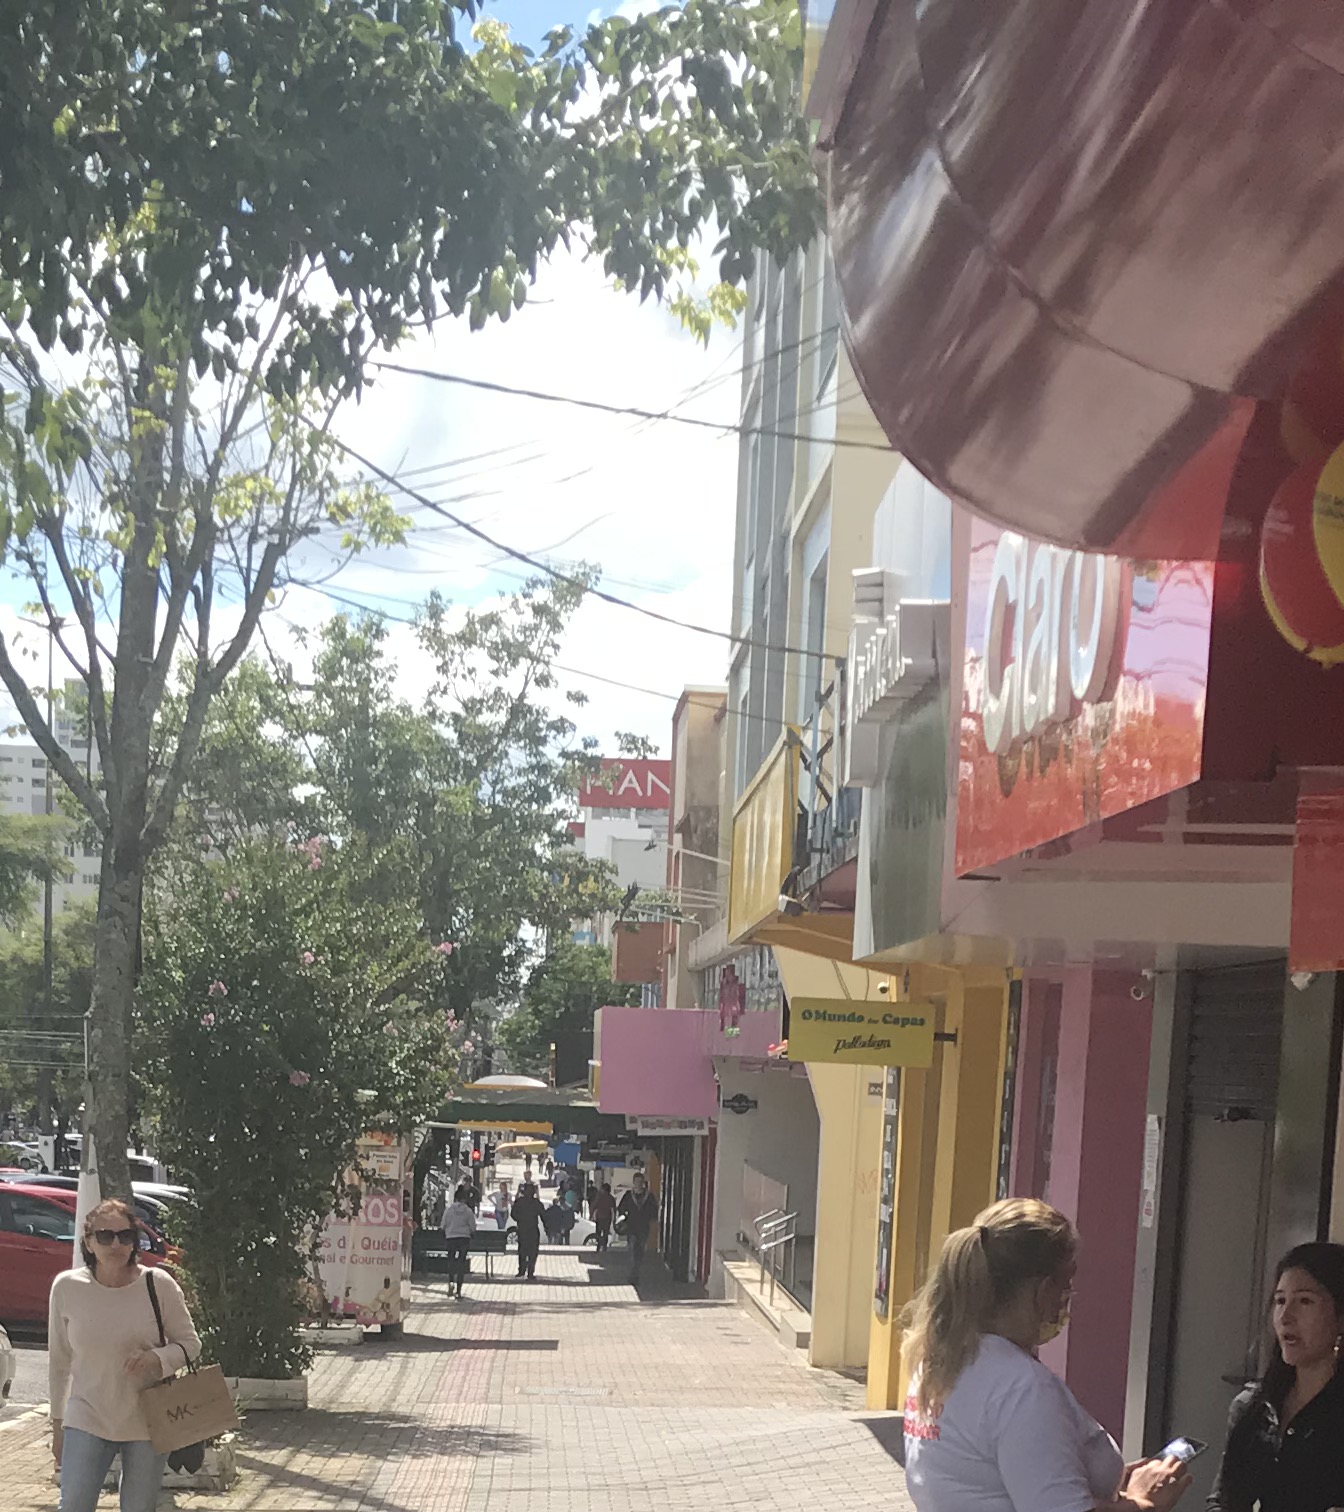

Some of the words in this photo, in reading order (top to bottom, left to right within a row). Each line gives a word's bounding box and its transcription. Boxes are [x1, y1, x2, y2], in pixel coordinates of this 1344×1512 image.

[801, 1009, 813, 1021] O
[814, 1010, 865, 1023] Mundo
[882, 1013, 926, 1028] Capas
[350, 1253, 395, 1266] Gourmet
